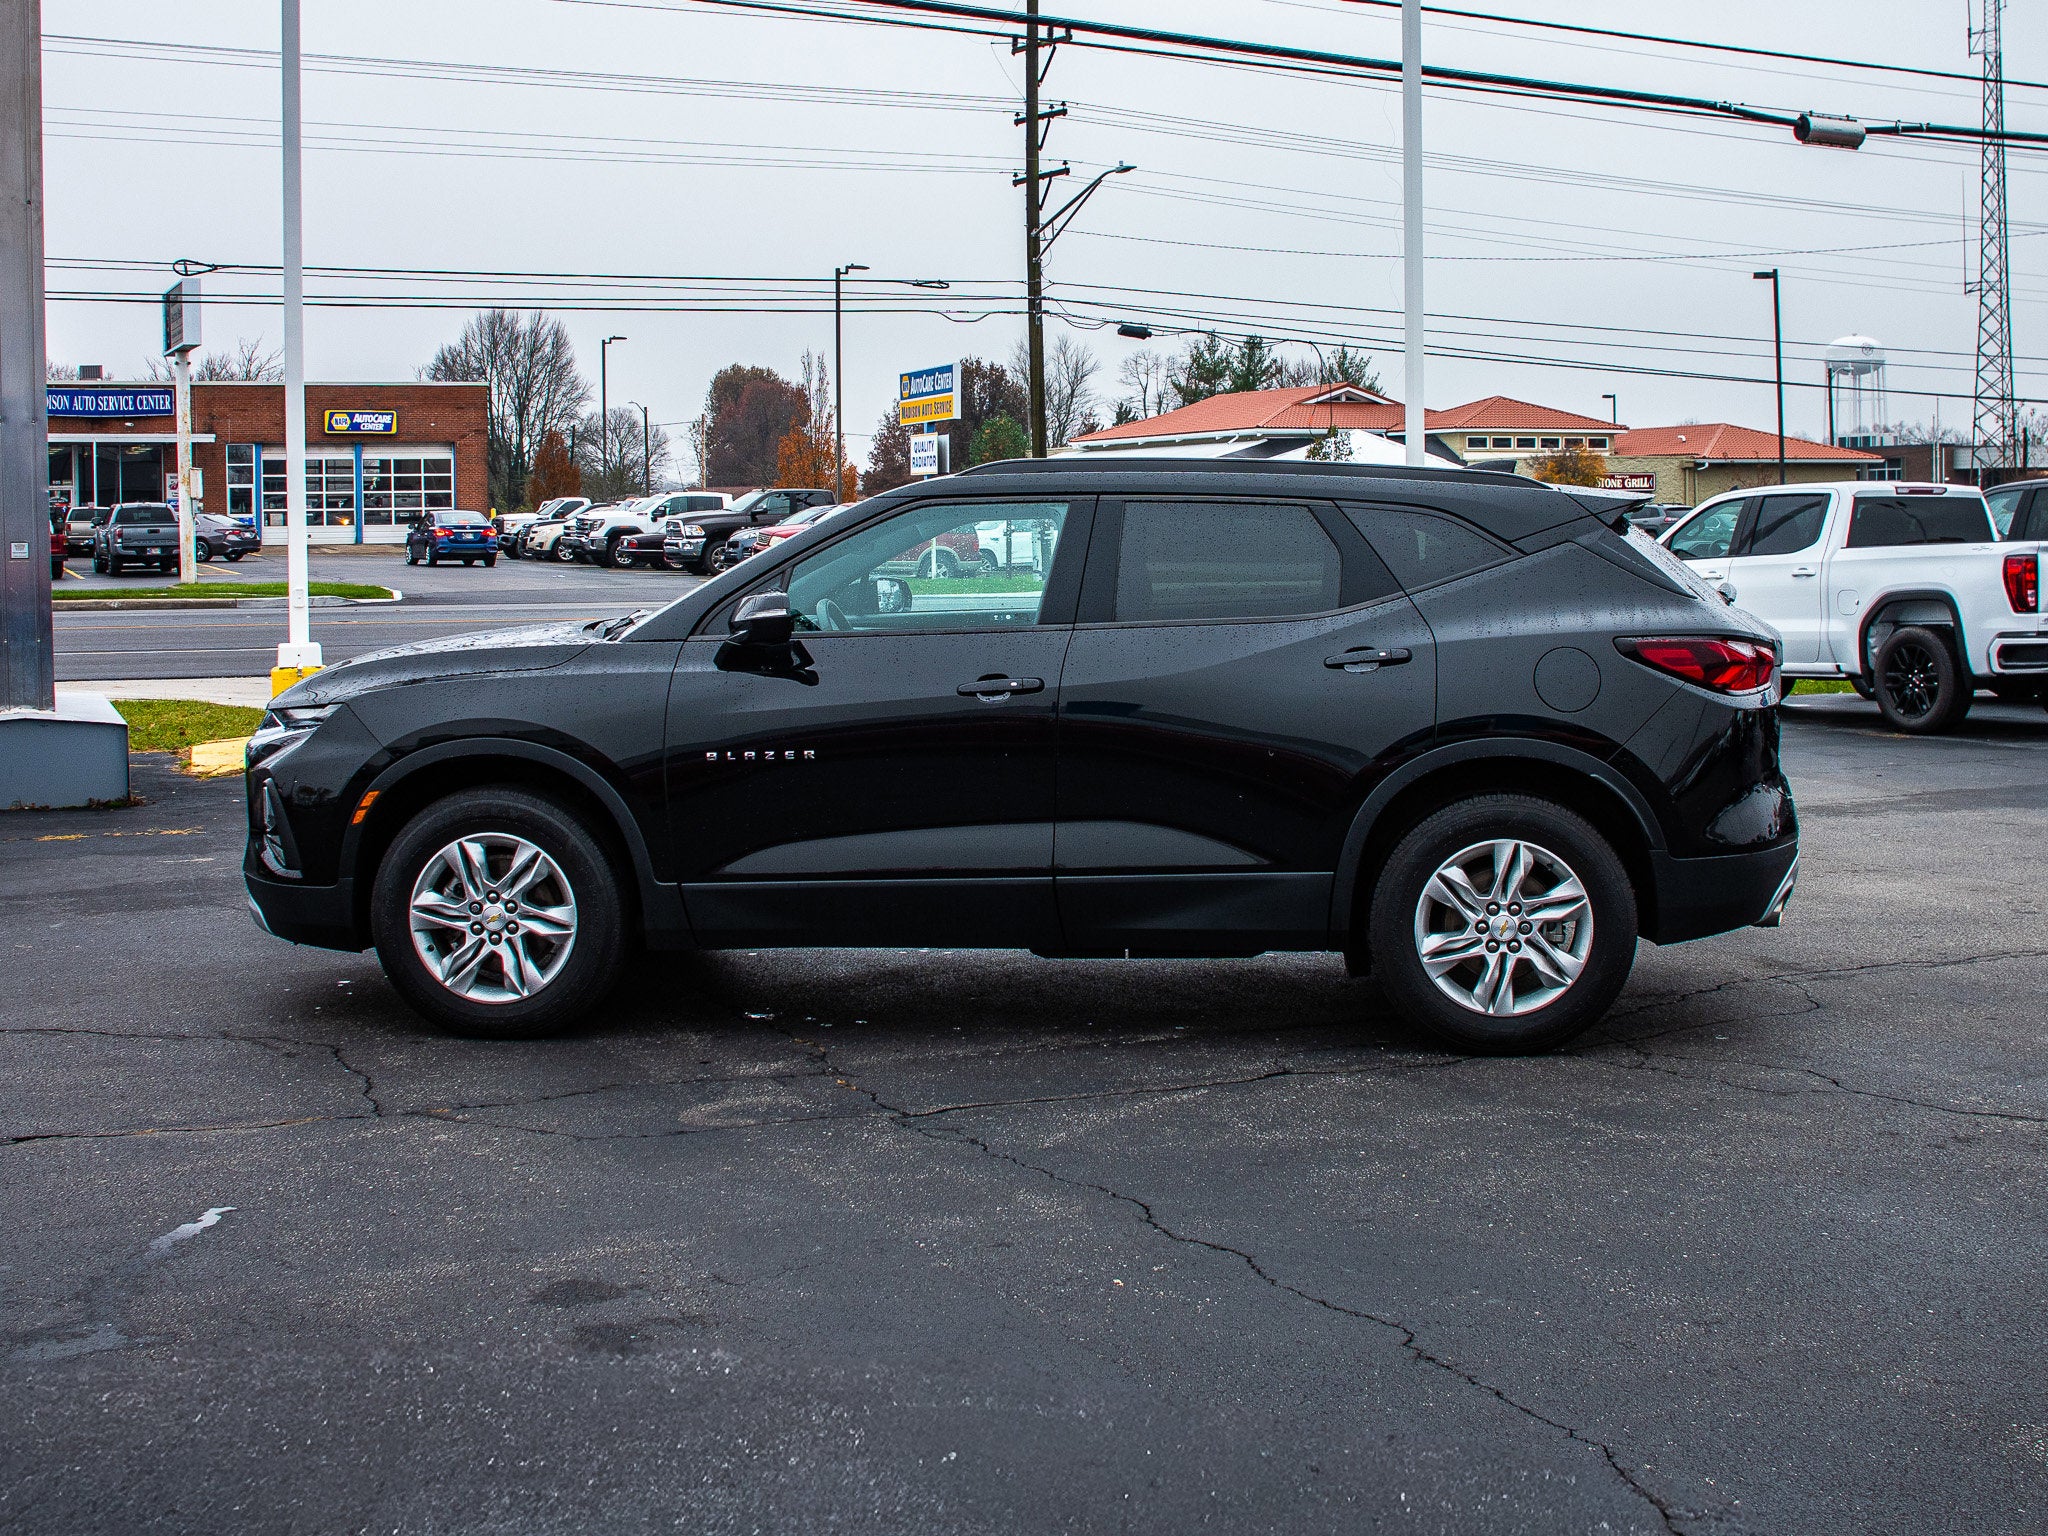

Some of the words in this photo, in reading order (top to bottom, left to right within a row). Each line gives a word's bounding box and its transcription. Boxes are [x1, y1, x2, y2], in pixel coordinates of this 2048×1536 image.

[72, 396, 96, 411] AUTO
[97, 396, 134, 411] SERVICE
[136, 395, 171, 410] CENTER
[901, 405, 921, 420] MADISON
[922, 403, 933, 417] AUTO
[934, 400, 952, 415] SERVICE
[360, 423, 384, 431] CENTER
[914, 440, 935, 454] QUALITY
[912, 455, 937, 468] RADIATOR
[1624, 477, 1650, 488] GRILL
[705, 750, 816, 761] BLAZER
